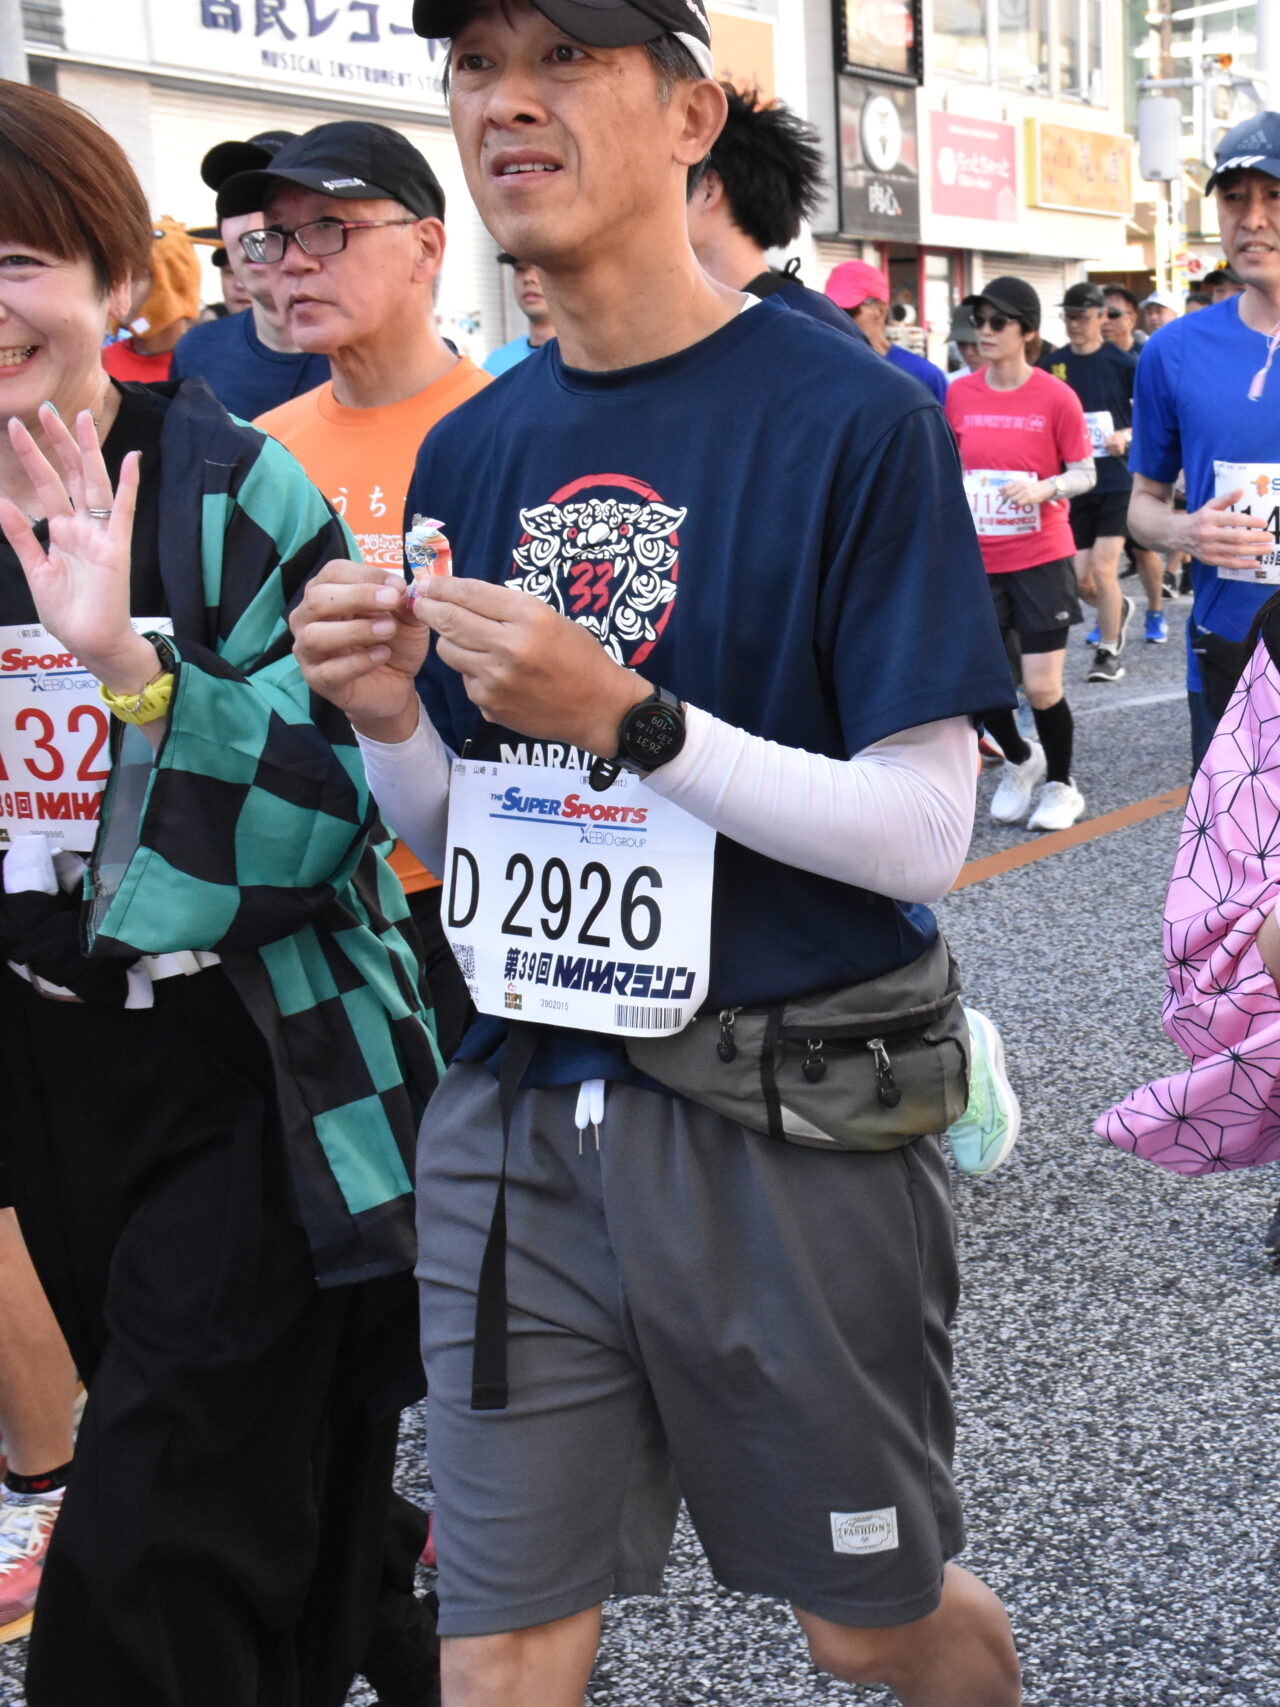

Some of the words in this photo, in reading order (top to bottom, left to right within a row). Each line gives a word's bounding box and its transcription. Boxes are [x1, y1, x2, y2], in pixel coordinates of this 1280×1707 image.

[261, 49, 322, 76] MUSICAL
[329, 60, 412, 87] INSTRUMENT
[1, 648, 84, 671] SPOR
[490, 793, 503, 802] THE
[501, 786, 562, 816] SUPER
[561, 793, 648, 824] SPORTS
[448, 846, 480, 928] D
[501, 852, 663, 951] 2926
[540, 998, 569, 1011] 3902015
[843, 1524, 885, 1537] FASHION
